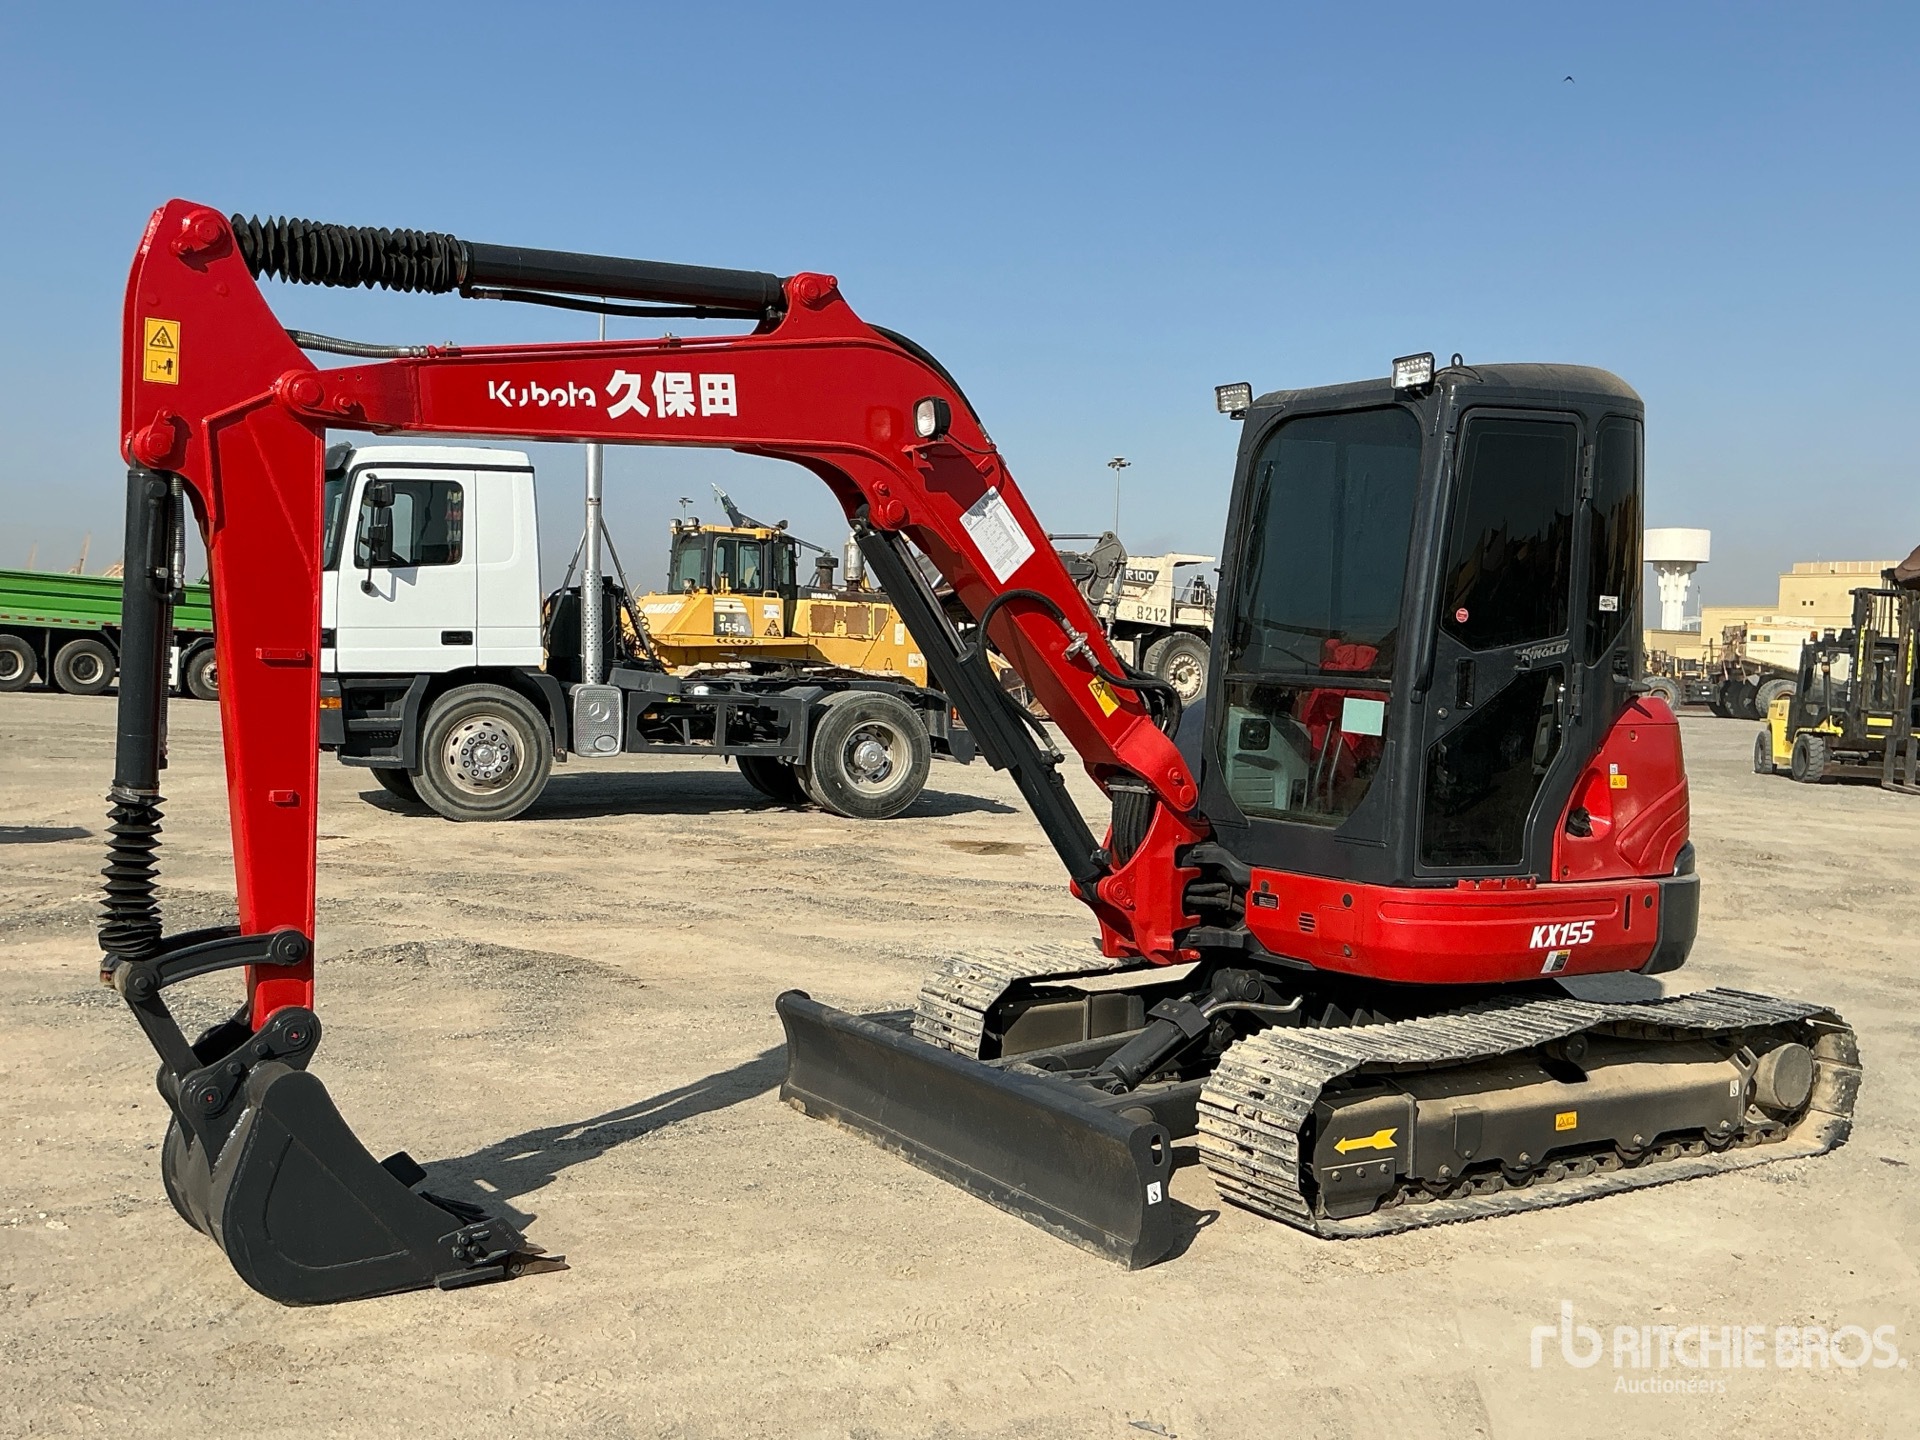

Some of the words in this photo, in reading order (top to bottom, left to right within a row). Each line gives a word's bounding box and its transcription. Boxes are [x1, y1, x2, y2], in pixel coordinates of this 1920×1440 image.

[488, 380, 597, 408] Kubota
[605, 369, 738, 419] 久保田
[1125, 570, 1154, 582] R100
[1137, 605, 1167, 623] 8212
[719, 622, 745, 633] 155A
[1529, 920, 1596, 949] KX155
